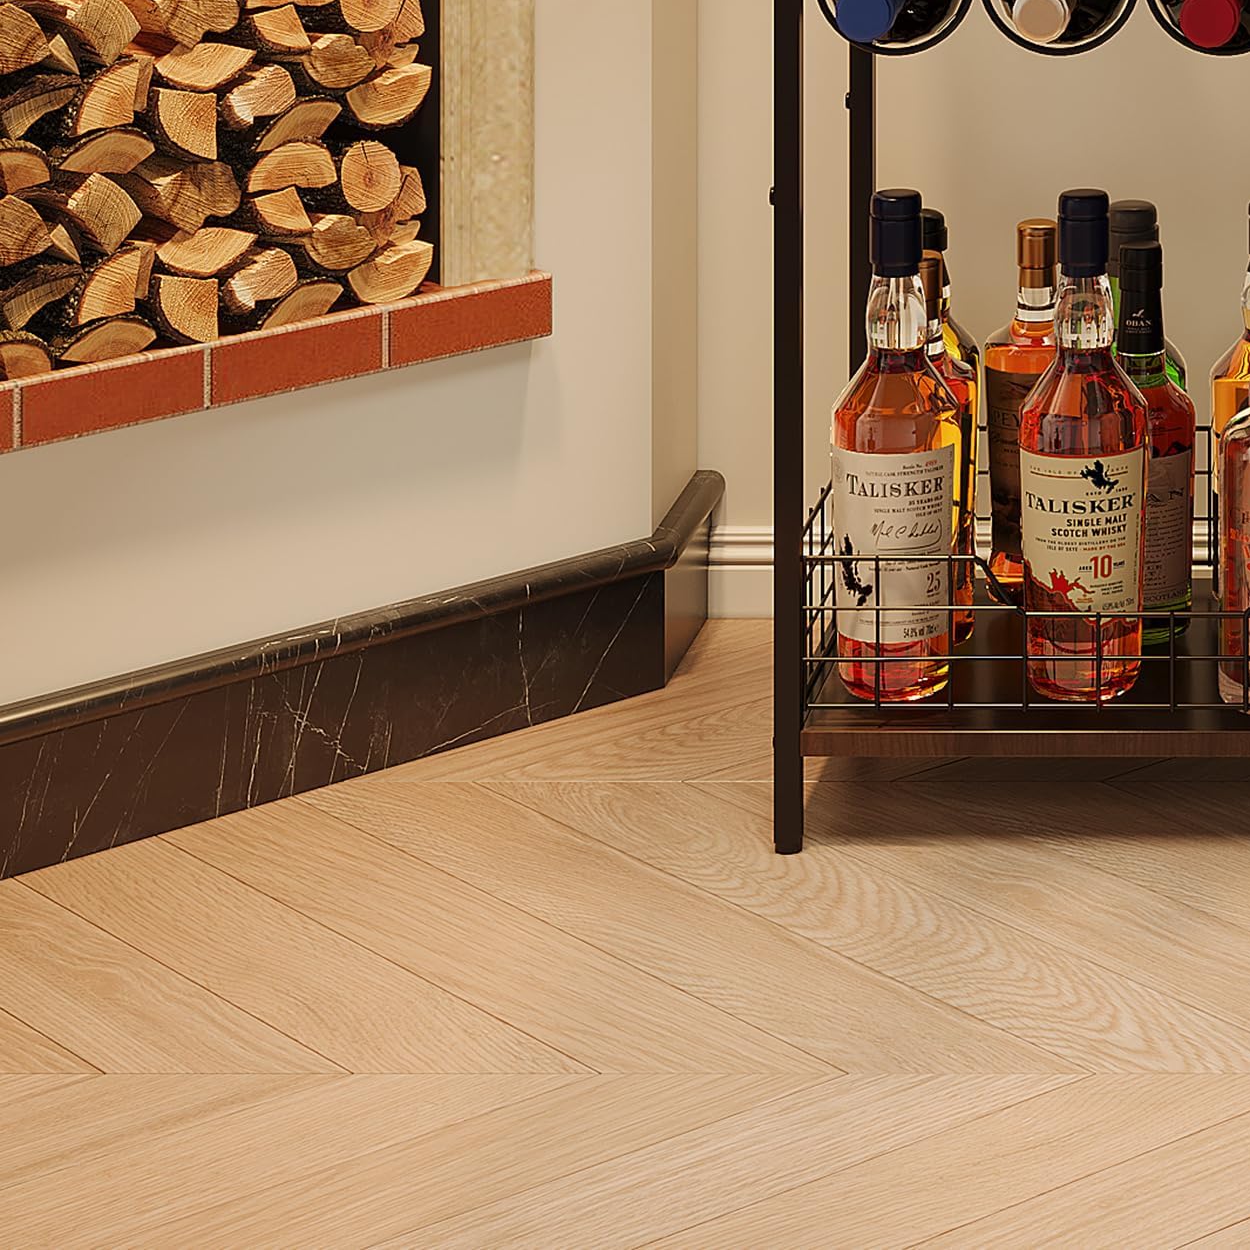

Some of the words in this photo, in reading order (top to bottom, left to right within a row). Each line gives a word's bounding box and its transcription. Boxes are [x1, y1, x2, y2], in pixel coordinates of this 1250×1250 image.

[845, 473, 944, 498] TALISKER
[1025, 492, 1134, 514] TALISKER
[1051, 528, 1088, 537] SCOTCH
[1091, 524, 1127, 536] WHISKY
[1066, 518, 1102, 527] SINGLE
[1105, 513, 1128, 524] MALT
[1089, 553, 1113, 579] 10
[926, 570, 941, 594] 25
